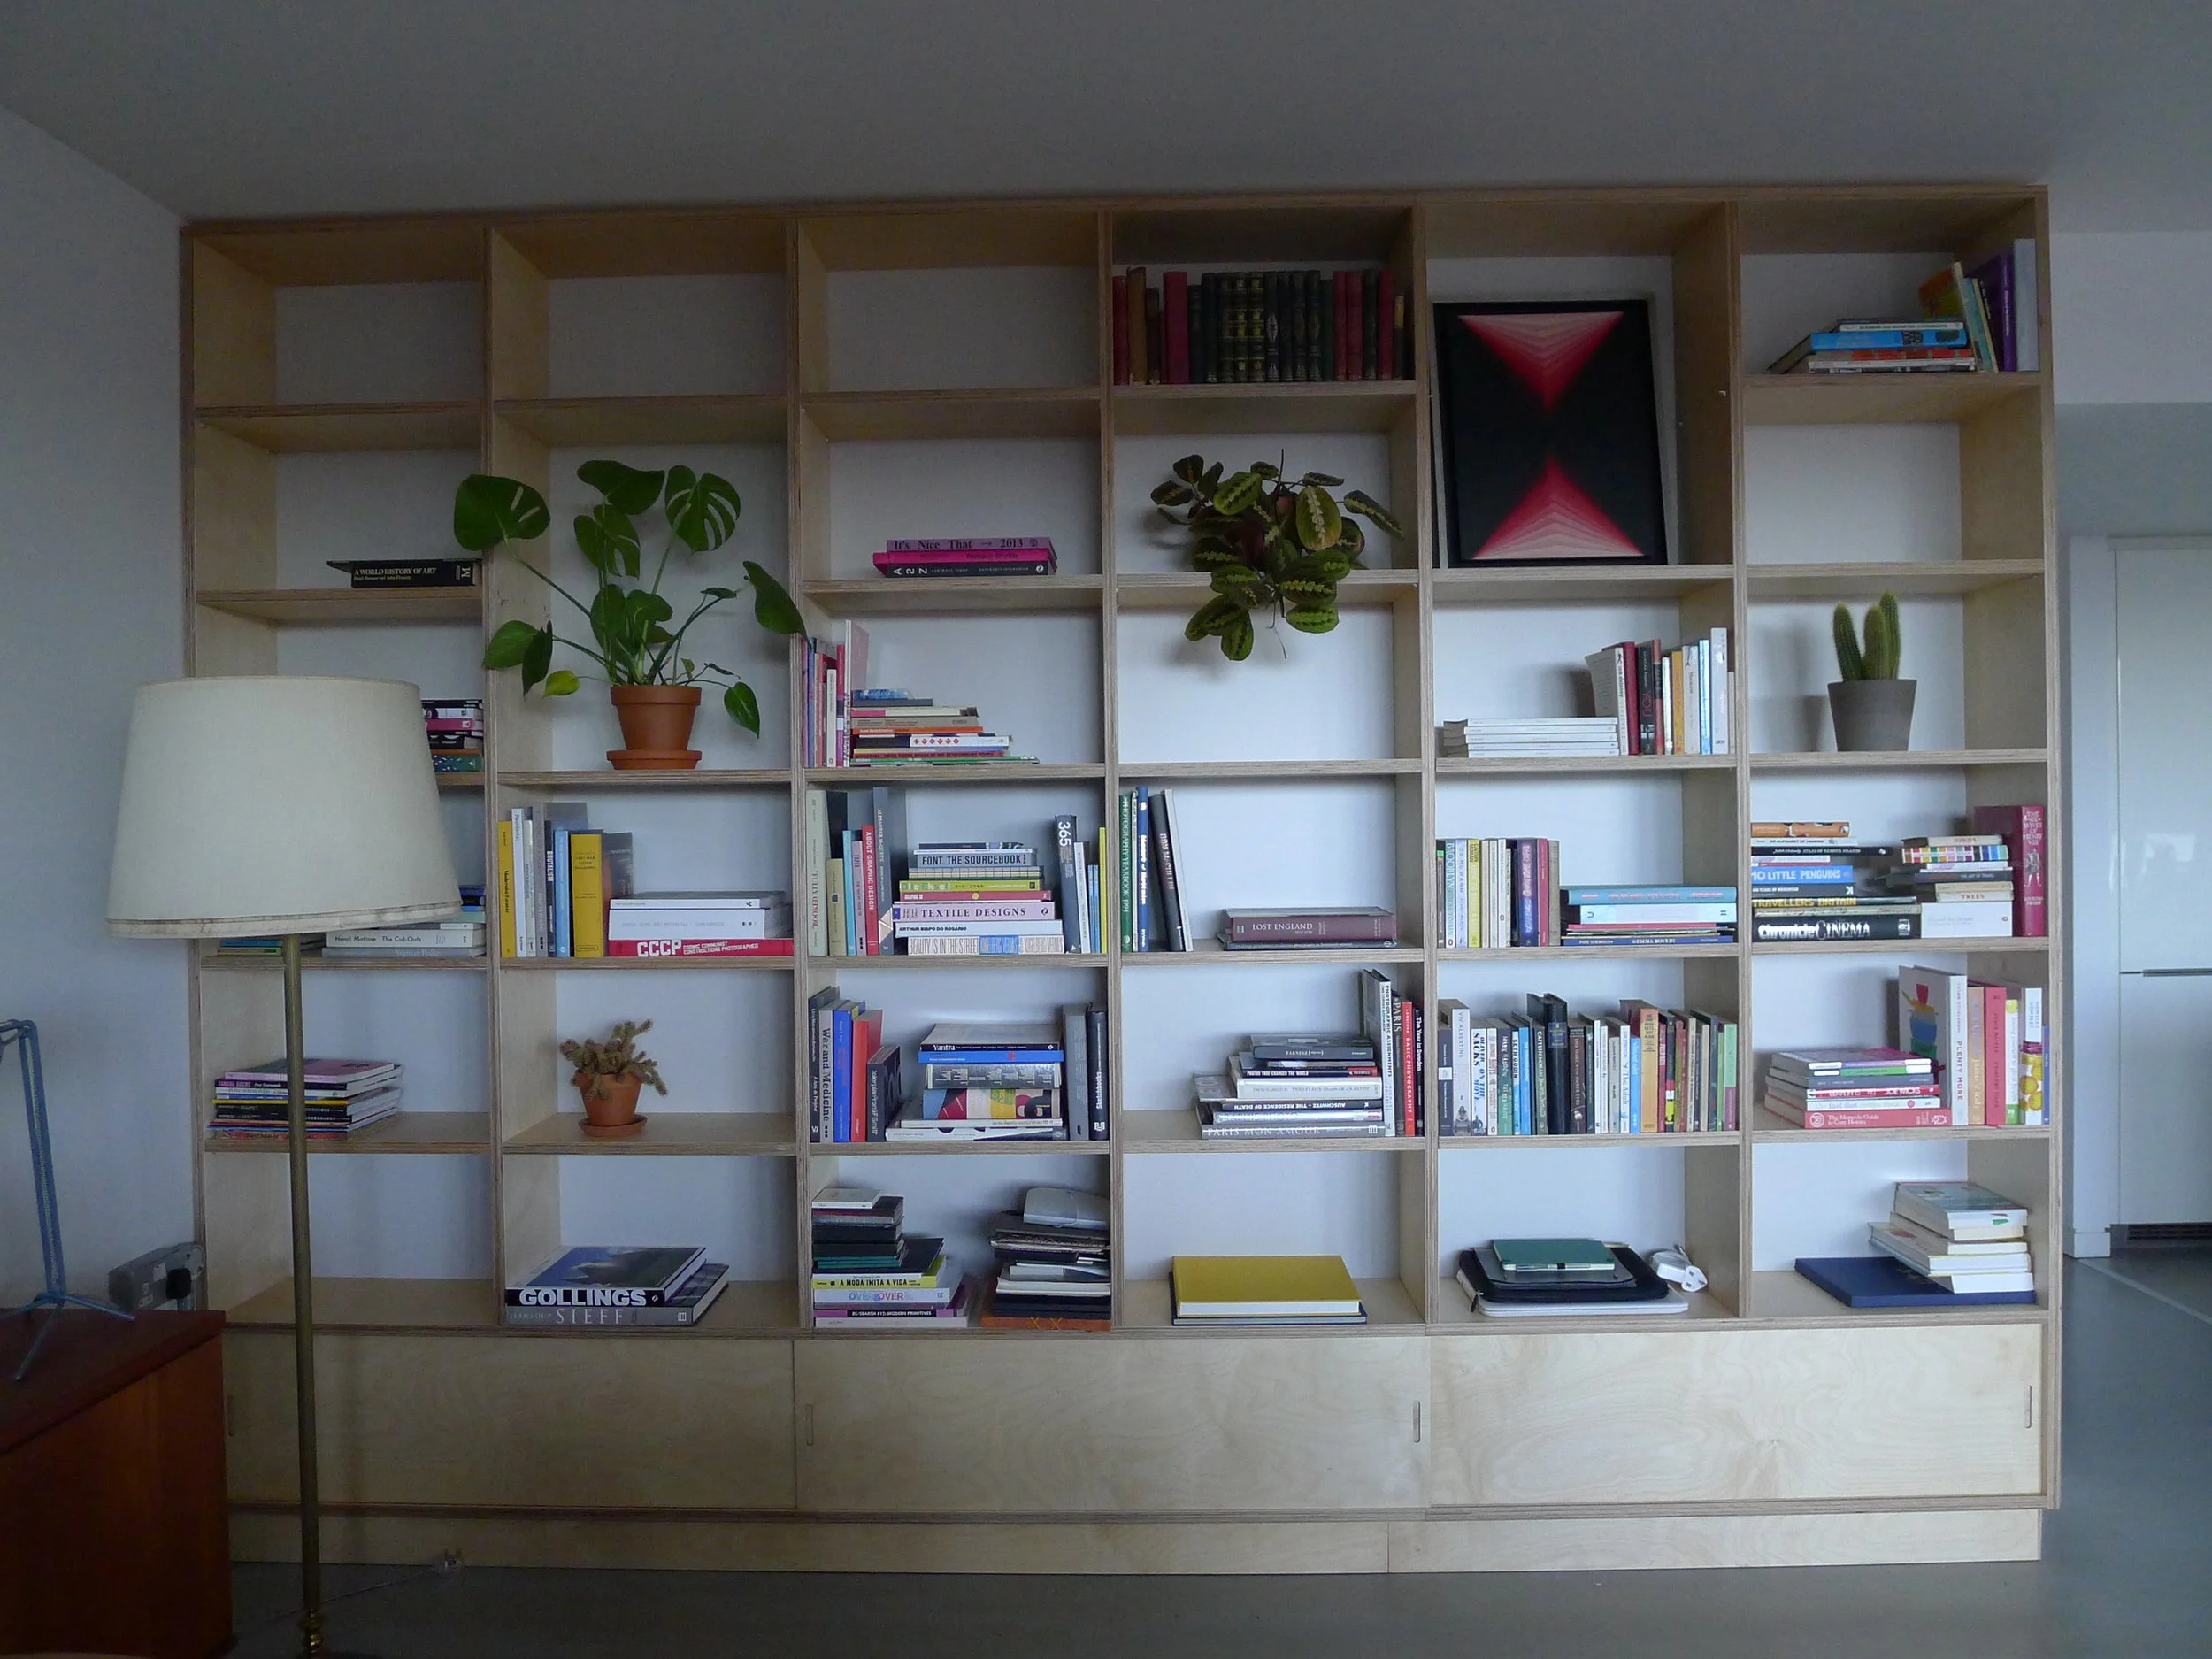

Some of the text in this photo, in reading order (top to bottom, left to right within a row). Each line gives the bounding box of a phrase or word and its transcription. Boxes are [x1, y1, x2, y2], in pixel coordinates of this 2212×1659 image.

[894, 538, 1022, 549] It's Nice That 2013
[1058, 822, 1072, 847] 365
[922, 855, 1021, 865] FONT THE SOURCEBOOK
[1751, 869, 1841, 880] 10 LITTLE PENGUINS
[920, 907, 1025, 918] TEXTILE DESIGNS
[637, 939, 681, 957] CCCP
[908, 937, 932, 955] BEAUTY
[933, 937, 938, 954] IS
[939, 937, 947, 954] IN
[948, 937, 958, 954] THE
[959, 937, 979, 954] STREET
[1393, 1002, 1402, 1032] PARIS
[822, 1027, 832, 1122] War and Medicine
[1479, 1068, 1485, 1079] ON
[519, 1287, 648, 1307] GOLLINGS
[556, 1308, 624, 1325] SIEFF
